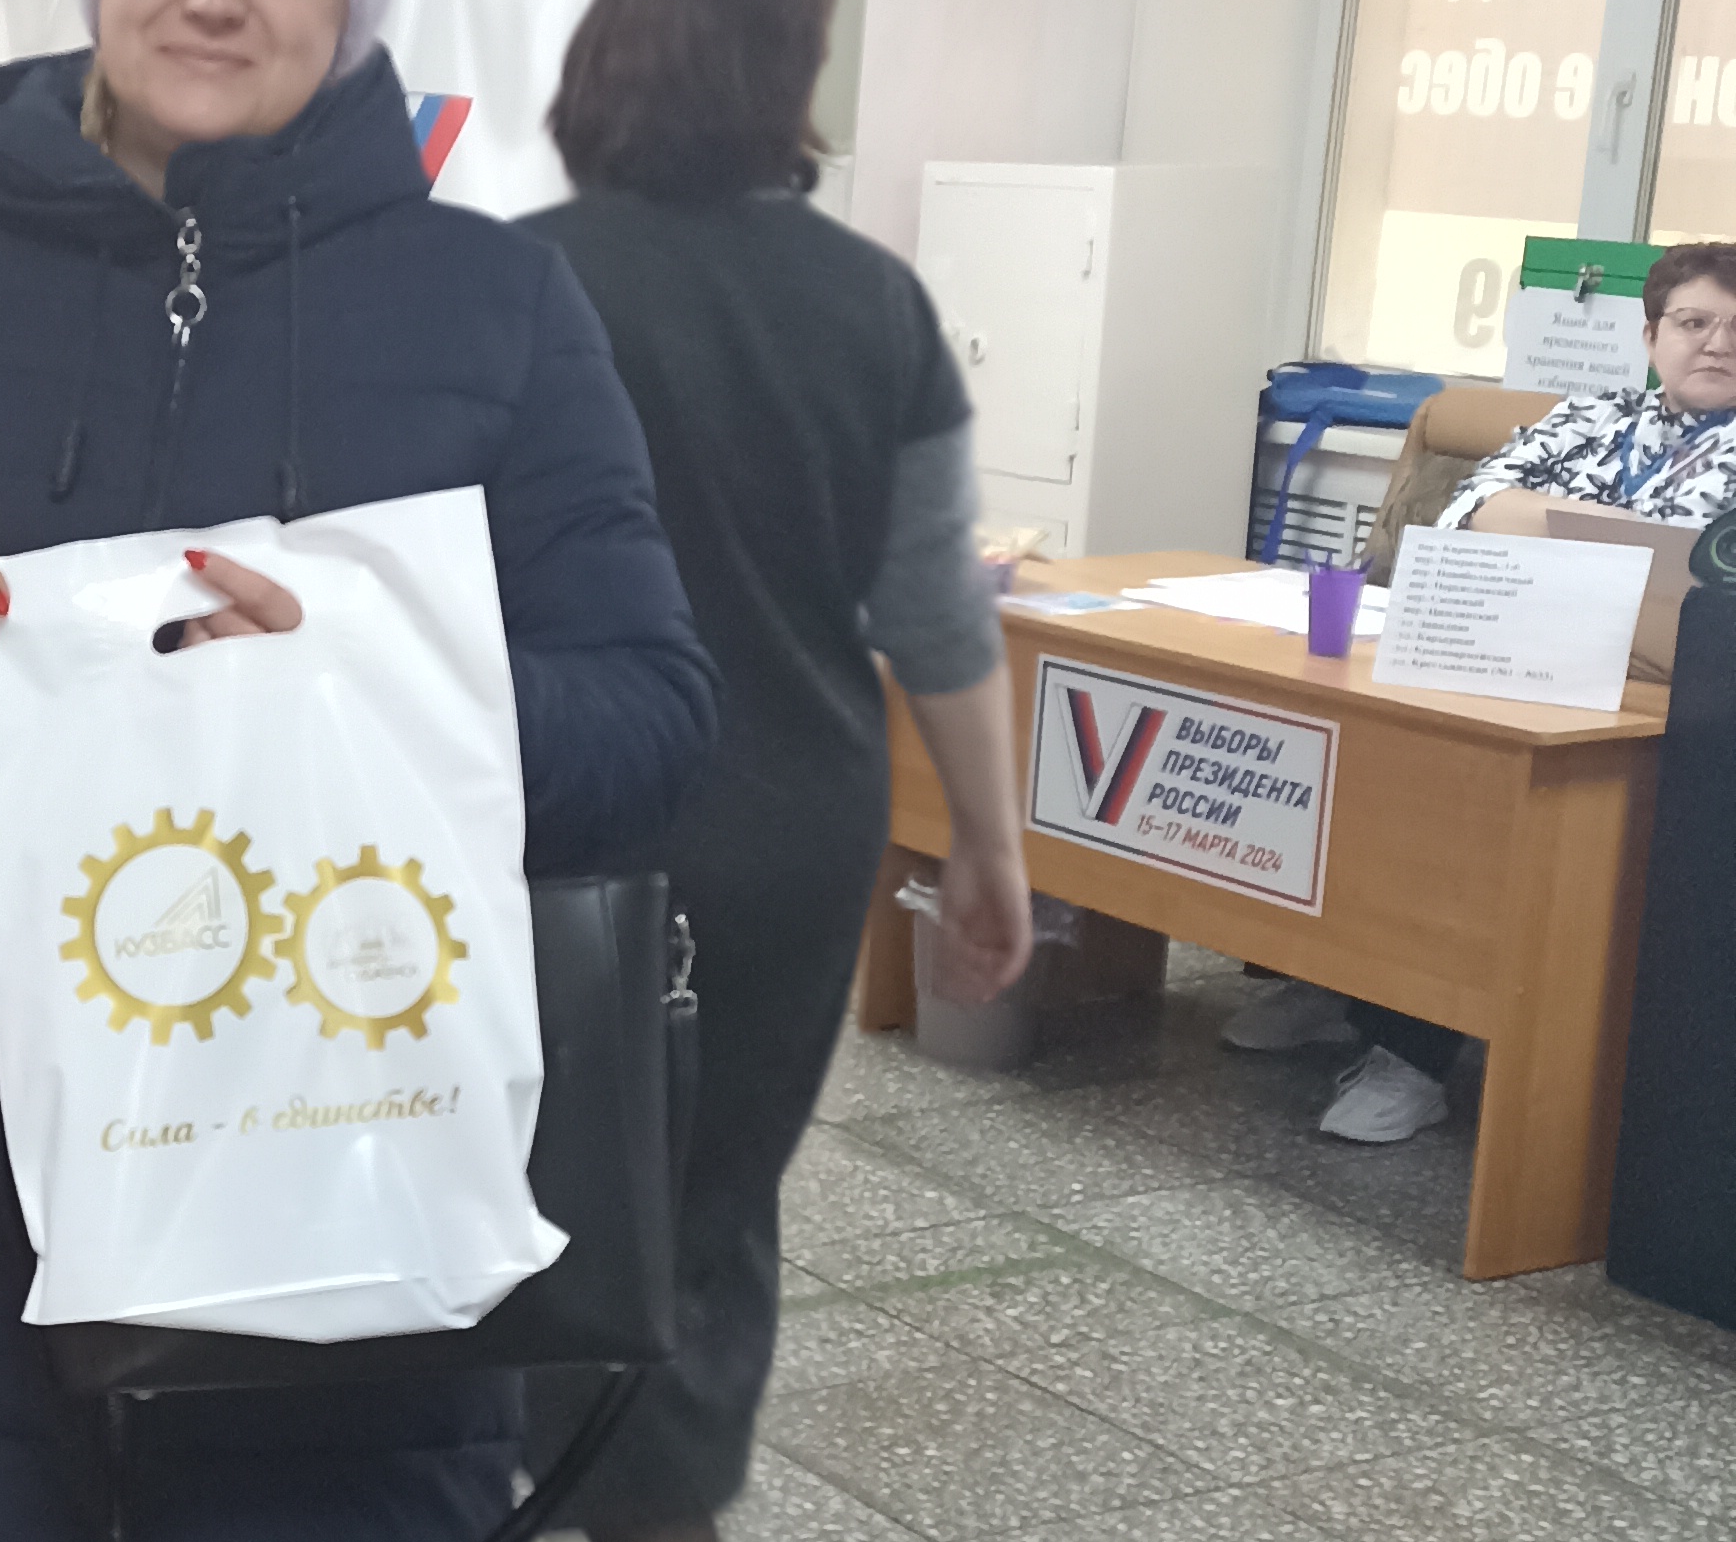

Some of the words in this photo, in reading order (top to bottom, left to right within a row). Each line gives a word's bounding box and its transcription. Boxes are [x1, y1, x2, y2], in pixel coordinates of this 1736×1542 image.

[1175, 716, 1285, 764] ВЫБОРЫ
[1161, 749, 1313, 810] ПРЕЗИДЕНТА
[1147, 782, 1242, 828] РОССИИ
[1181, 826, 1240, 861] МАРТА
[1239, 844, 1284, 873] 2024
[100, 1118, 195, 1152] Сила
[272, 1084, 461, 1132] единстве!
